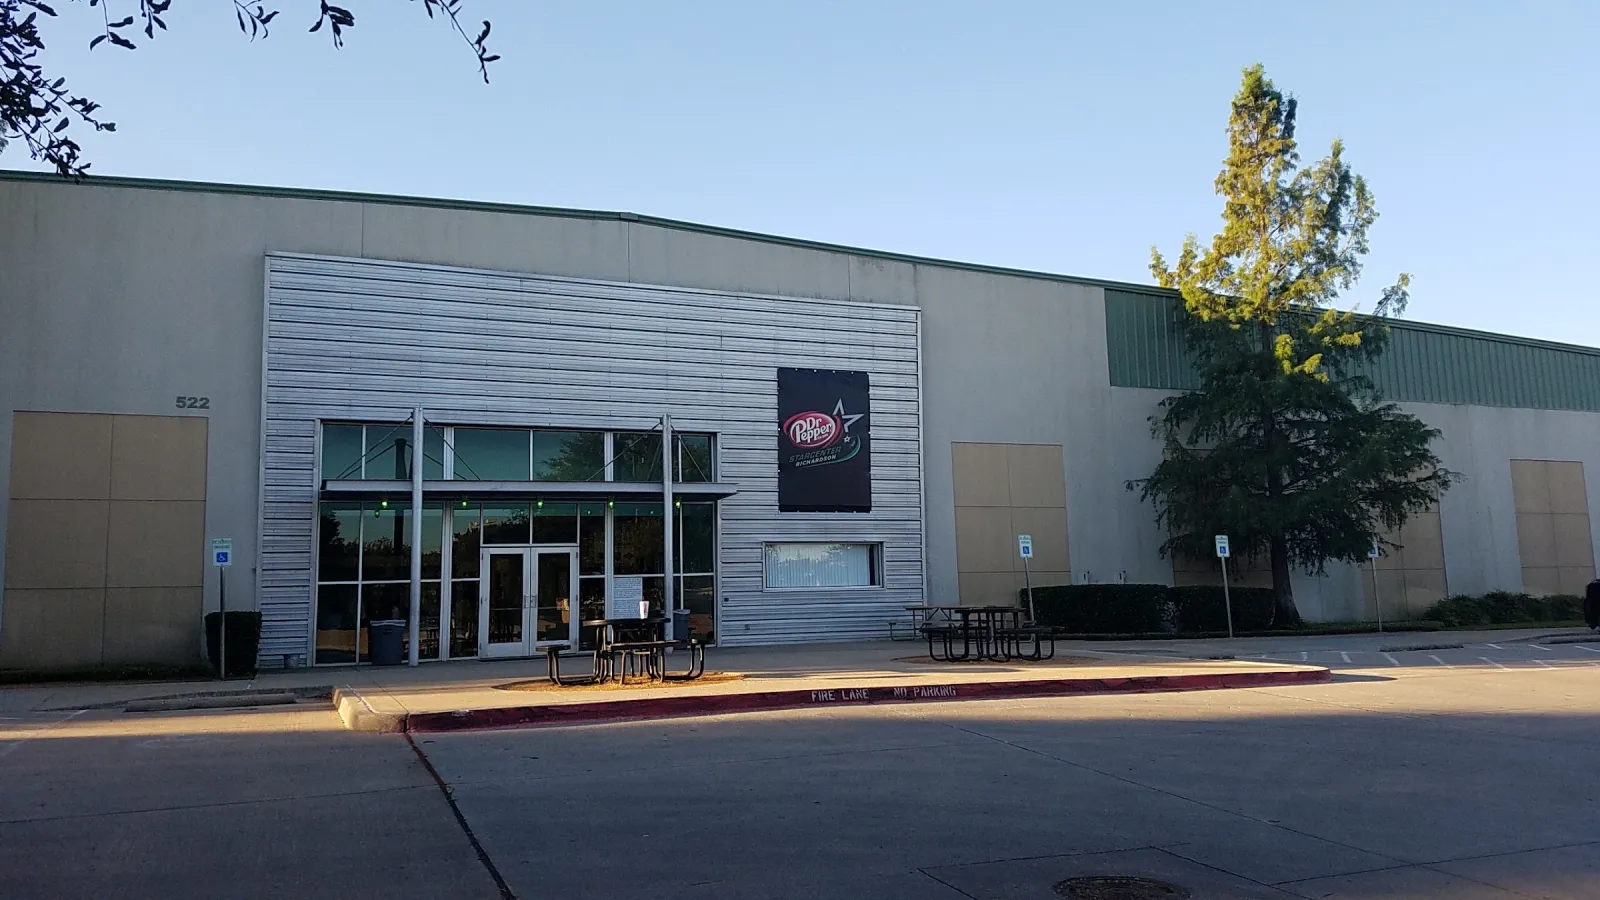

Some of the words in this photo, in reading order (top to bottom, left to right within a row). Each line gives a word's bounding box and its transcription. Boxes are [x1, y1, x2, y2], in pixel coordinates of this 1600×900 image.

[175, 396, 210, 409] 522
[806, 417, 822, 431] Dr
[795, 420, 832, 443] Pepper
[789, 446, 842, 462] STARCENTER
[795, 454, 837, 467] RICHARDSON
[811, 690, 835, 701] FIRE
[842, 688, 869, 700] LANE
[893, 687, 907, 697] NO
[914, 686, 956, 697] PARKING
